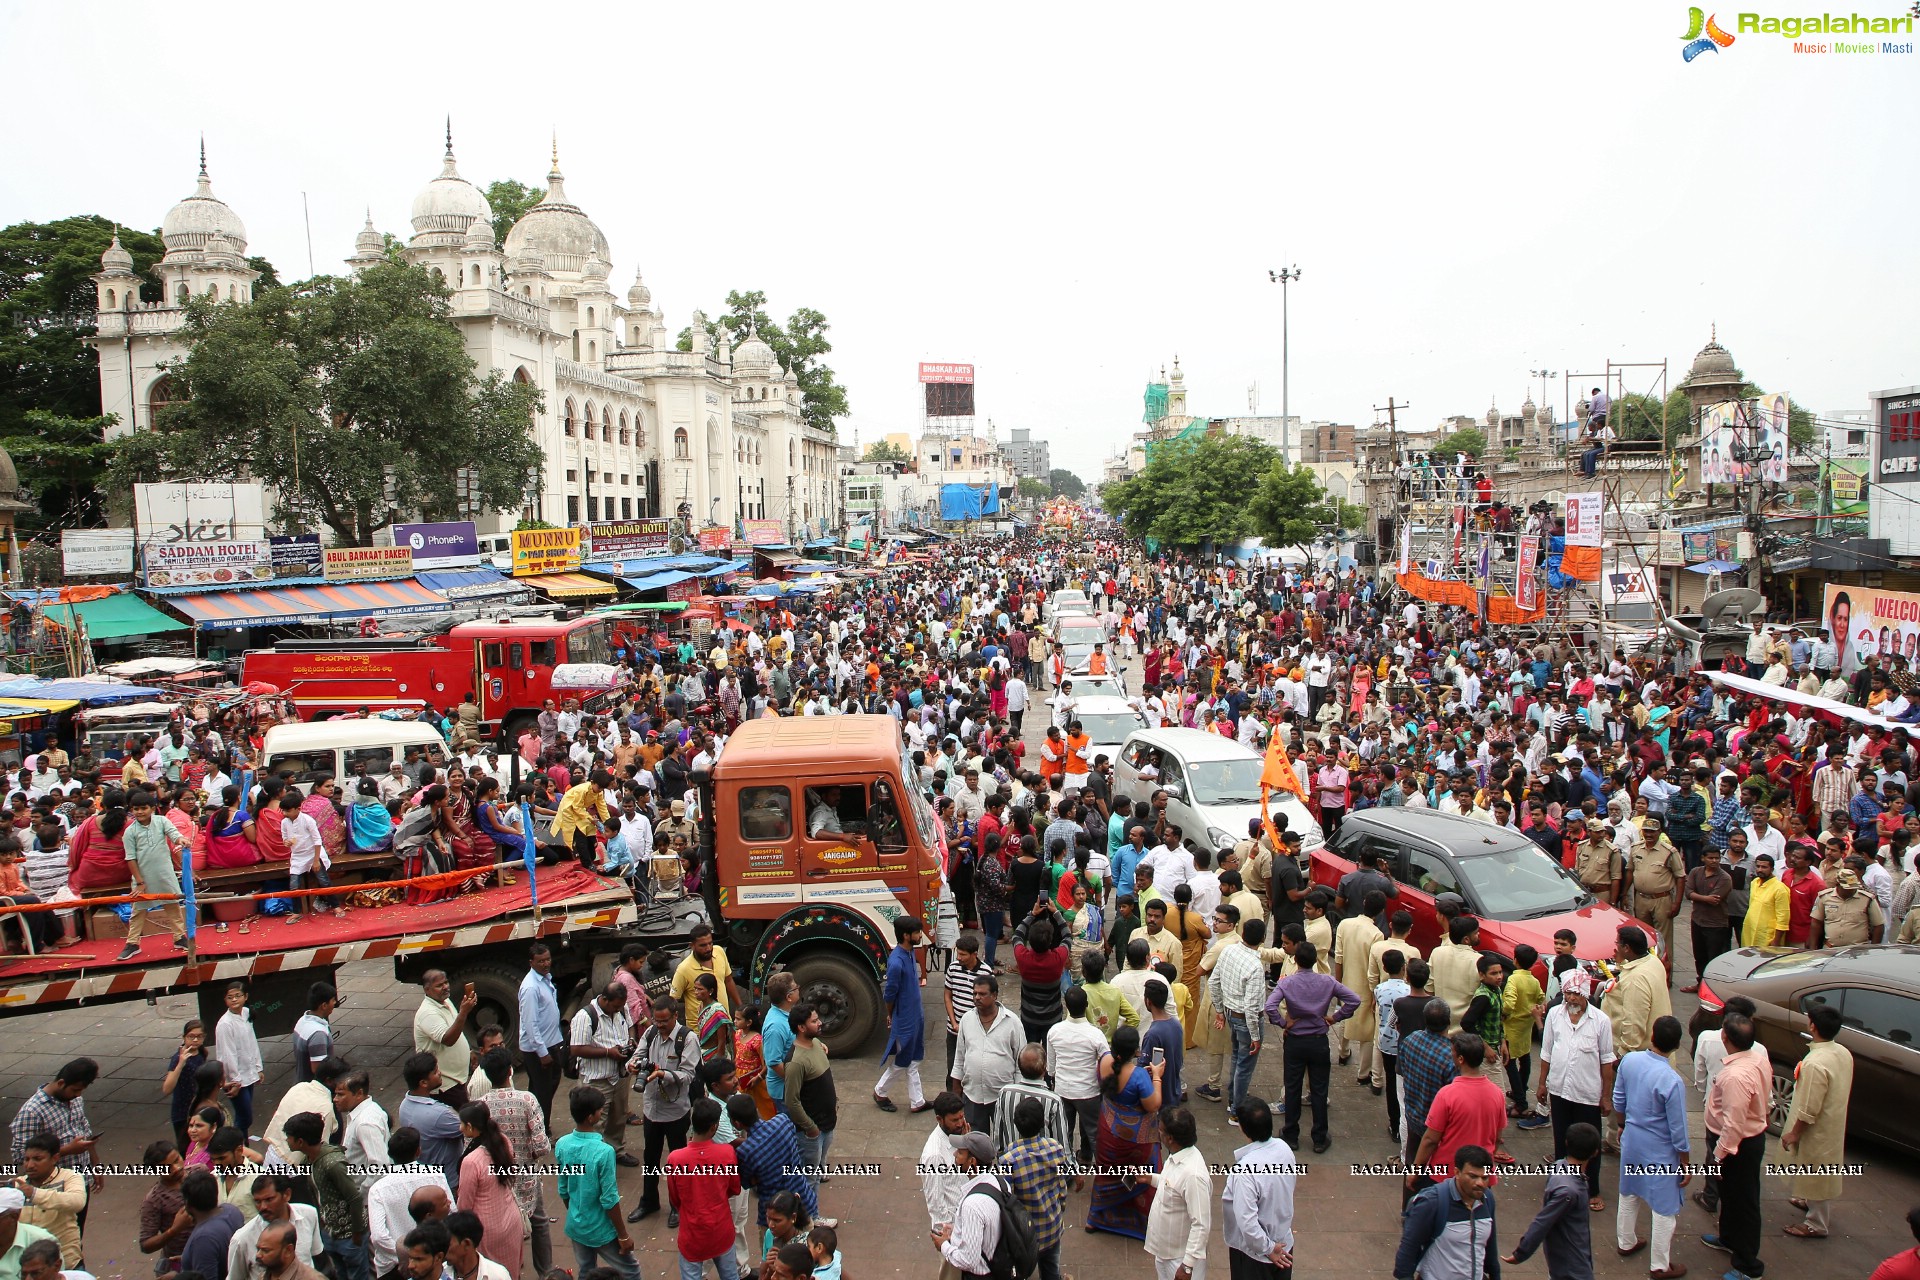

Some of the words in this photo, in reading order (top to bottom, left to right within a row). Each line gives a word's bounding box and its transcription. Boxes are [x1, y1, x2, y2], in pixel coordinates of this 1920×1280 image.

[922, 365, 953, 373] BHASKAR
[954, 366, 971, 374] ARTS
[1881, 456, 1918, 474] CAFE
[592, 525, 640, 537] MUQADDAR
[642, 523, 667, 534] HOTEL
[427, 534, 464, 545] PhonePe
[519, 531, 574, 548] MUNNU
[159, 545, 215, 558] SADDAM
[218, 544, 258, 555] HOTEL
[327, 552, 347, 562] ABUL
[349, 550, 382, 561] BARKAAT
[384, 549, 411, 559] BAKERY
[528, 549, 544, 558] PAN
[546, 548, 567, 557] SHOP
[187, 556, 209, 564] SECTION
[1874, 597, 1920, 622] WELCO
